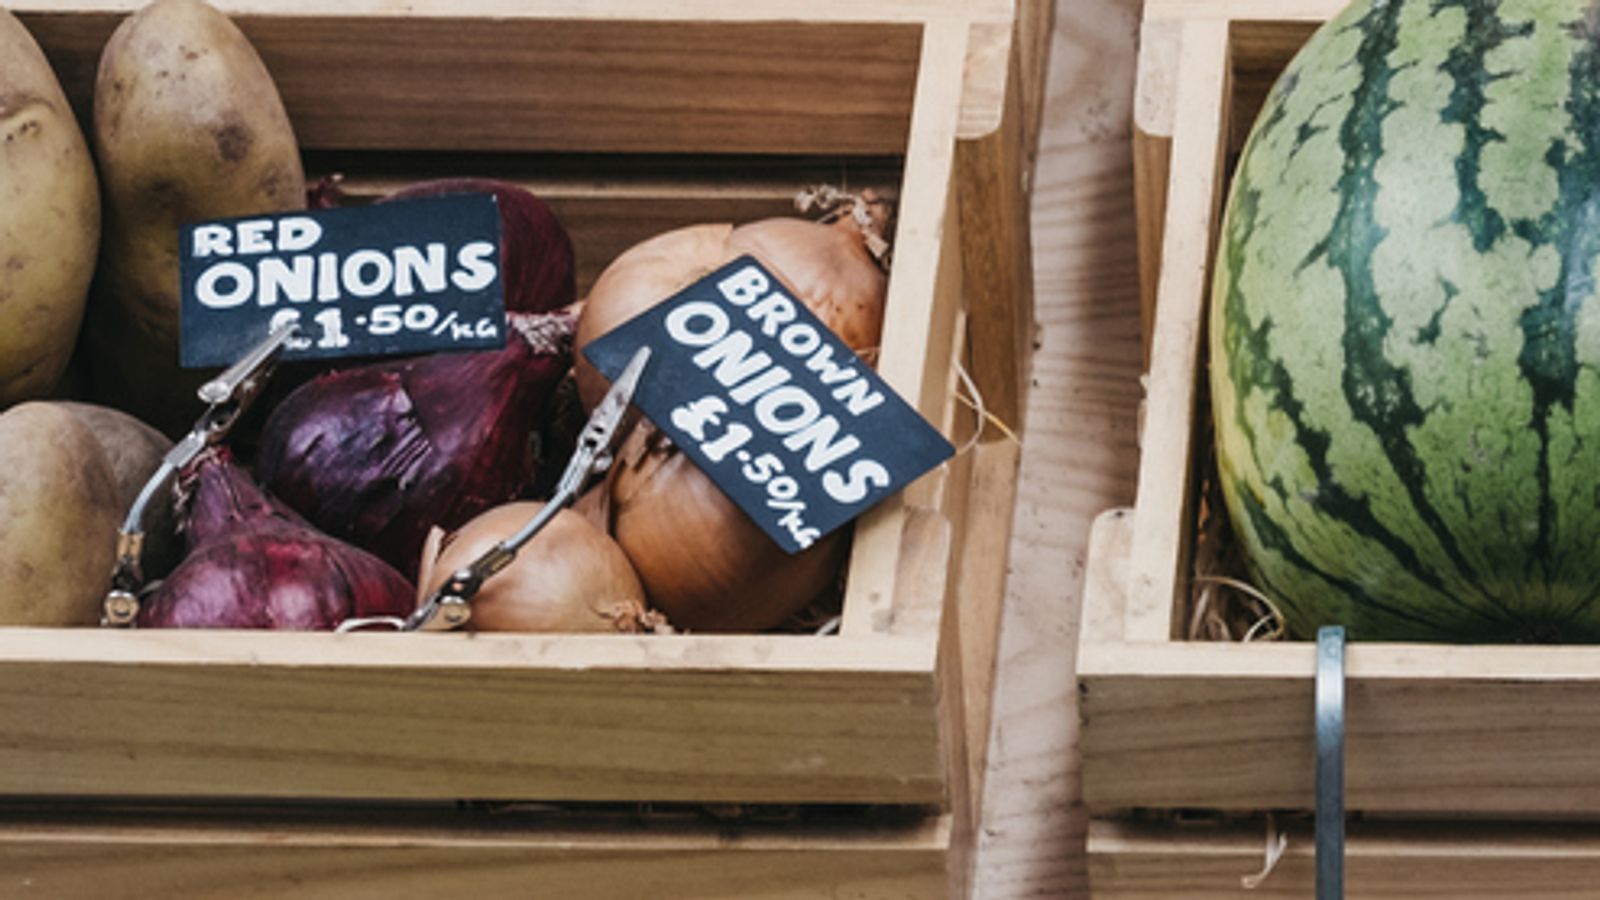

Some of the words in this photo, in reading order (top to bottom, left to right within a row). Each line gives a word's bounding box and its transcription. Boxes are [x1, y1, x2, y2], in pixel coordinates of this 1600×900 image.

[191, 217, 322, 257] RED
[195, 241, 497, 308] ONIONS
[717, 265, 885, 416] BROWN
[665, 301, 890, 503] ONIONS
